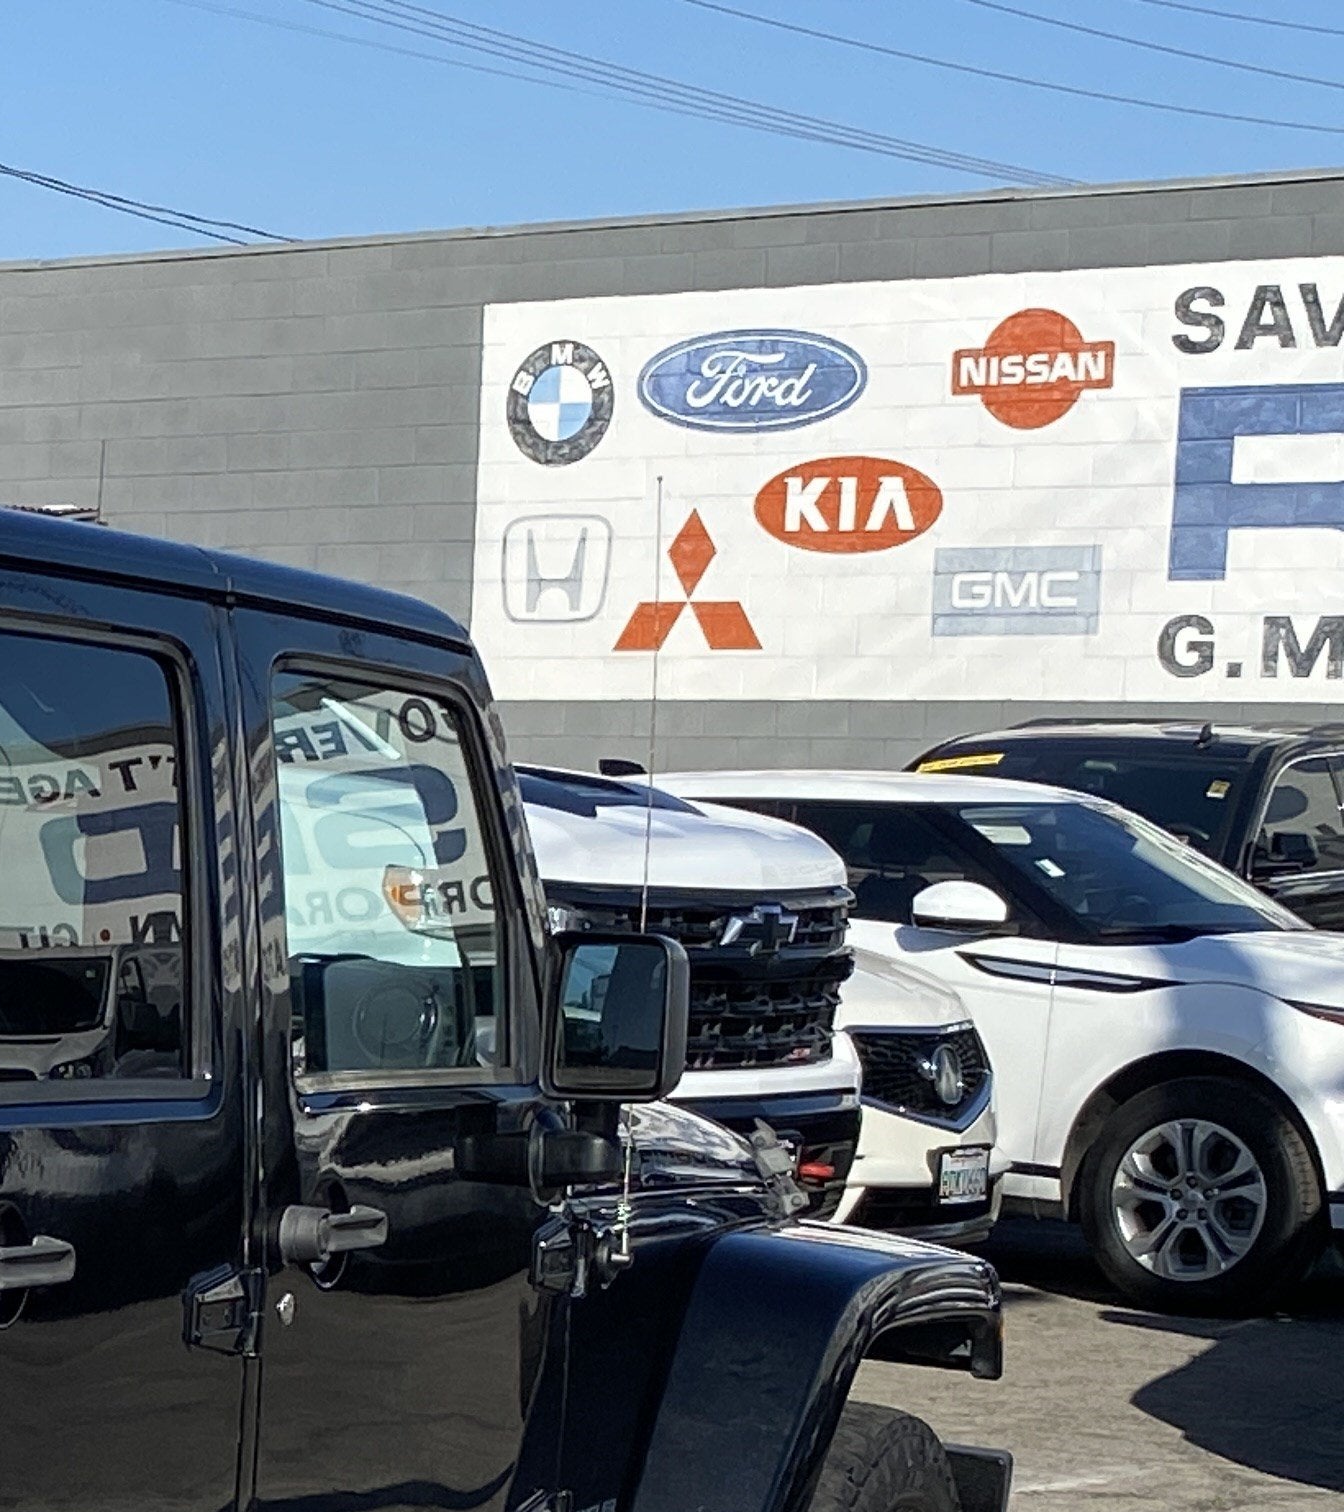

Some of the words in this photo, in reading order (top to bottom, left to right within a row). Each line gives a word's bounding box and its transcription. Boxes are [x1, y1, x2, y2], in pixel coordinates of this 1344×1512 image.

[685, 350, 818, 409] Ford
[959, 350, 1107, 388] NISSAN
[782, 475, 916, 533] KIA
[950, 570, 1080, 609] GMC
